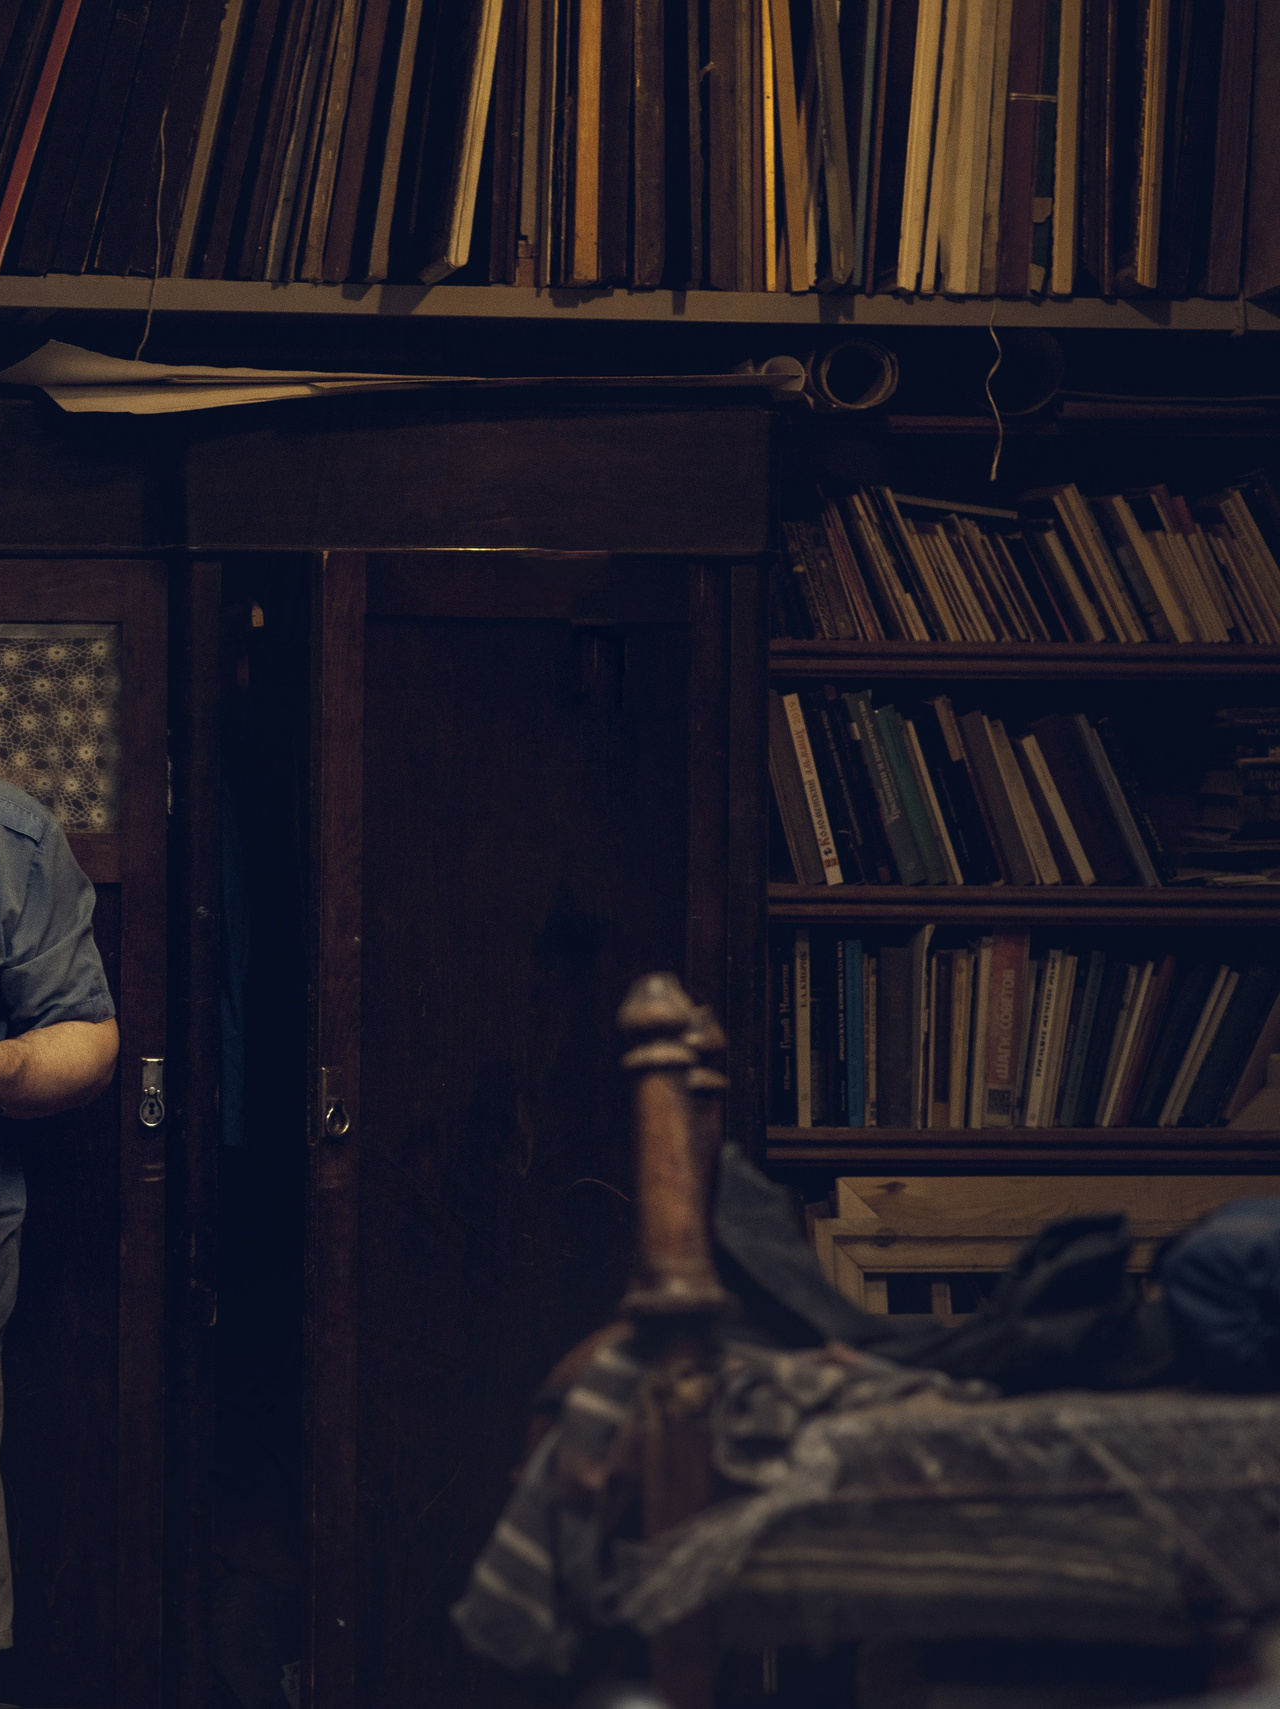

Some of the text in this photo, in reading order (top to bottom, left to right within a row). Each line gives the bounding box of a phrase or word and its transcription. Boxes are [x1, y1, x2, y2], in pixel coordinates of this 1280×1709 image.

[779, 964, 791, 1048] Гурий Никитин
[1000, 968, 1016, 1030] СОВЕТОВ
